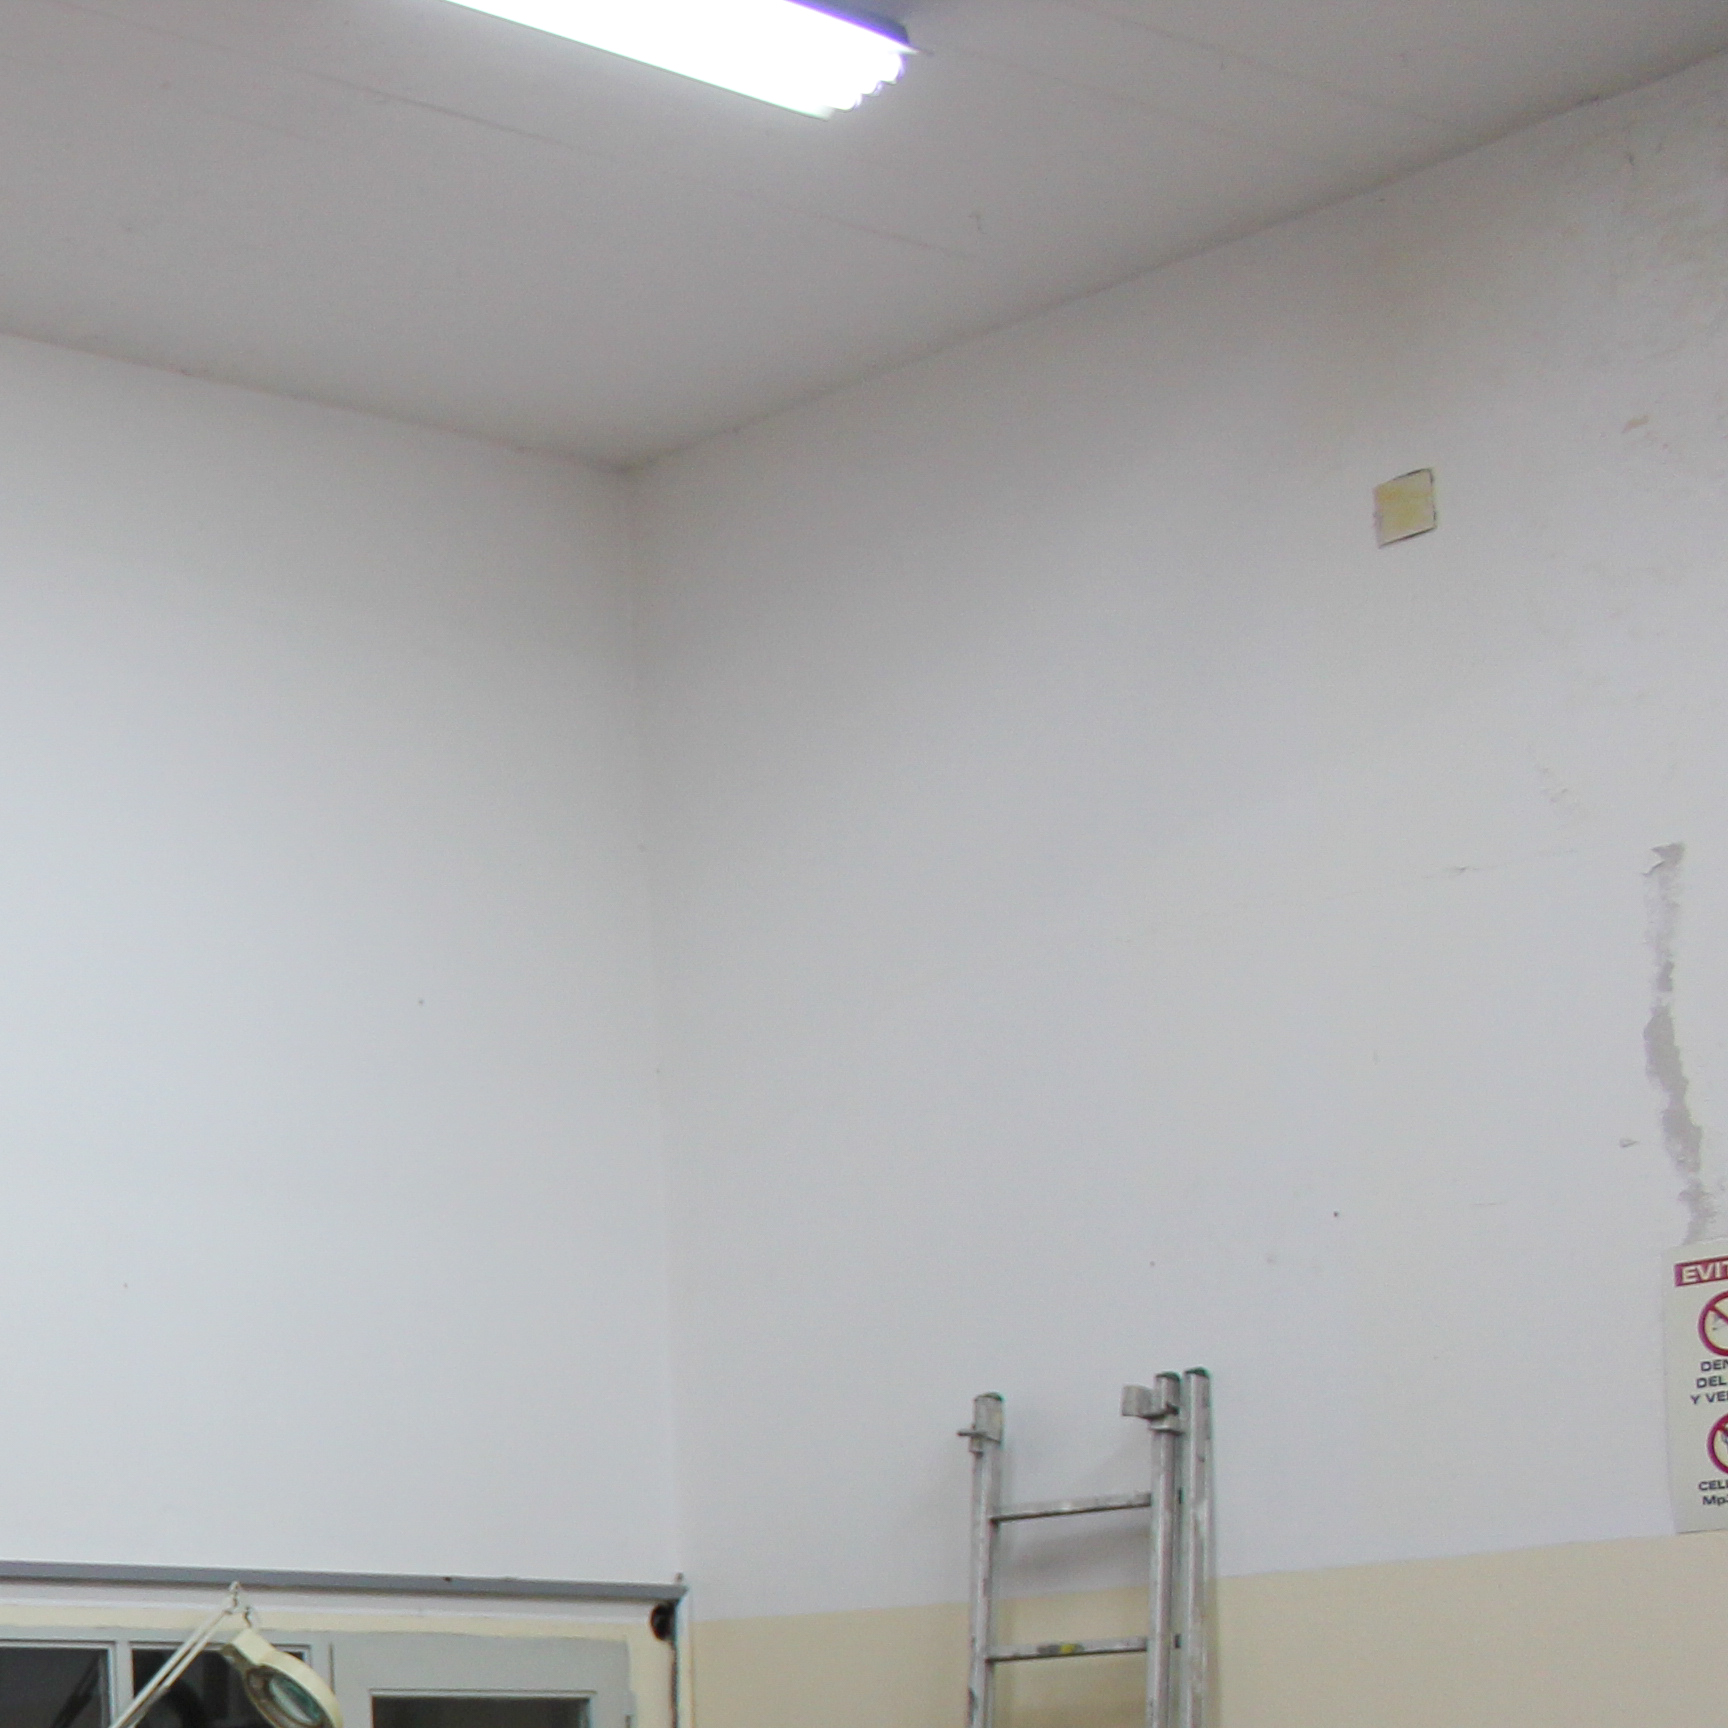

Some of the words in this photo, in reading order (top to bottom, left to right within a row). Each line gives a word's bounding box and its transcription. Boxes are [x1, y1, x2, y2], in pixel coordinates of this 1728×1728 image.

[1696, 1375, 1727, 1389] DEL
[1690, 1393, 1701, 1405] Y
[1705, 1390, 1728, 1403] VE
